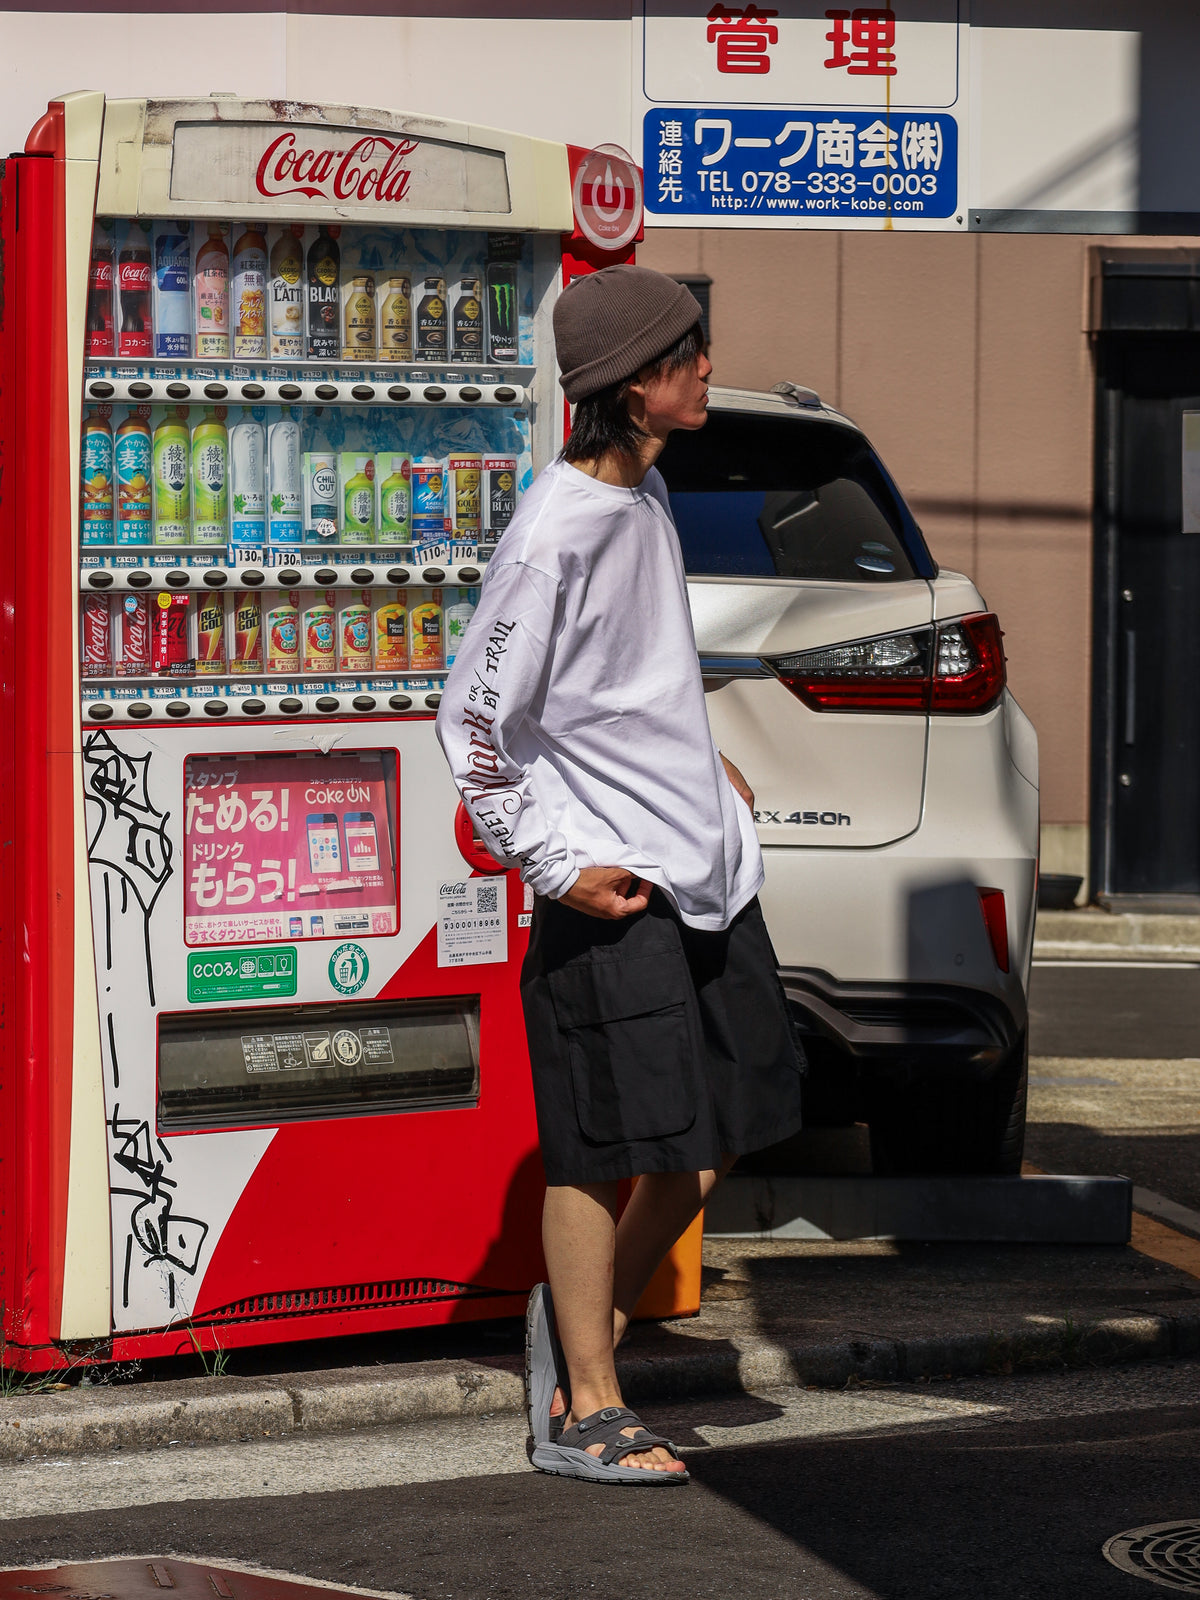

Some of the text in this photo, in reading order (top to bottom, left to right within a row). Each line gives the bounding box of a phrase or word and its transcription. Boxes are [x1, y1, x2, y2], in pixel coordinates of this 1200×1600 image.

[706, 3, 898, 76] 管理
[255, 132, 421, 202] Coca-Cola
[658, 120, 683, 203] 連絡先
[697, 171, 938, 195] TEL 078-333-0003
[711, 195, 924, 211] http://www.work-kobe.com
[310, 286, 337, 303] BLAC
[168, 444, 183, 481] 綾鷹
[206, 444, 222, 481] 綾鷹
[316, 475, 336, 484] CHILL
[318, 483, 335, 492] OUT
[239, 549, 262, 562] 130円
[278, 553, 300, 566] 130円
[423, 546, 446, 562] 110円
[455, 546, 477, 558] 110円
[486, 620, 517, 673] TRAIL
[304, 784, 371, 804] Coke ON
[186, 789, 290, 835] ためる!
[784, 811, 851, 826] 450h
[192, 842, 245, 861] ドリンク
[190, 859, 297, 908] もらう!
[188, 926, 282, 943] 今すぐダウンロード!!
